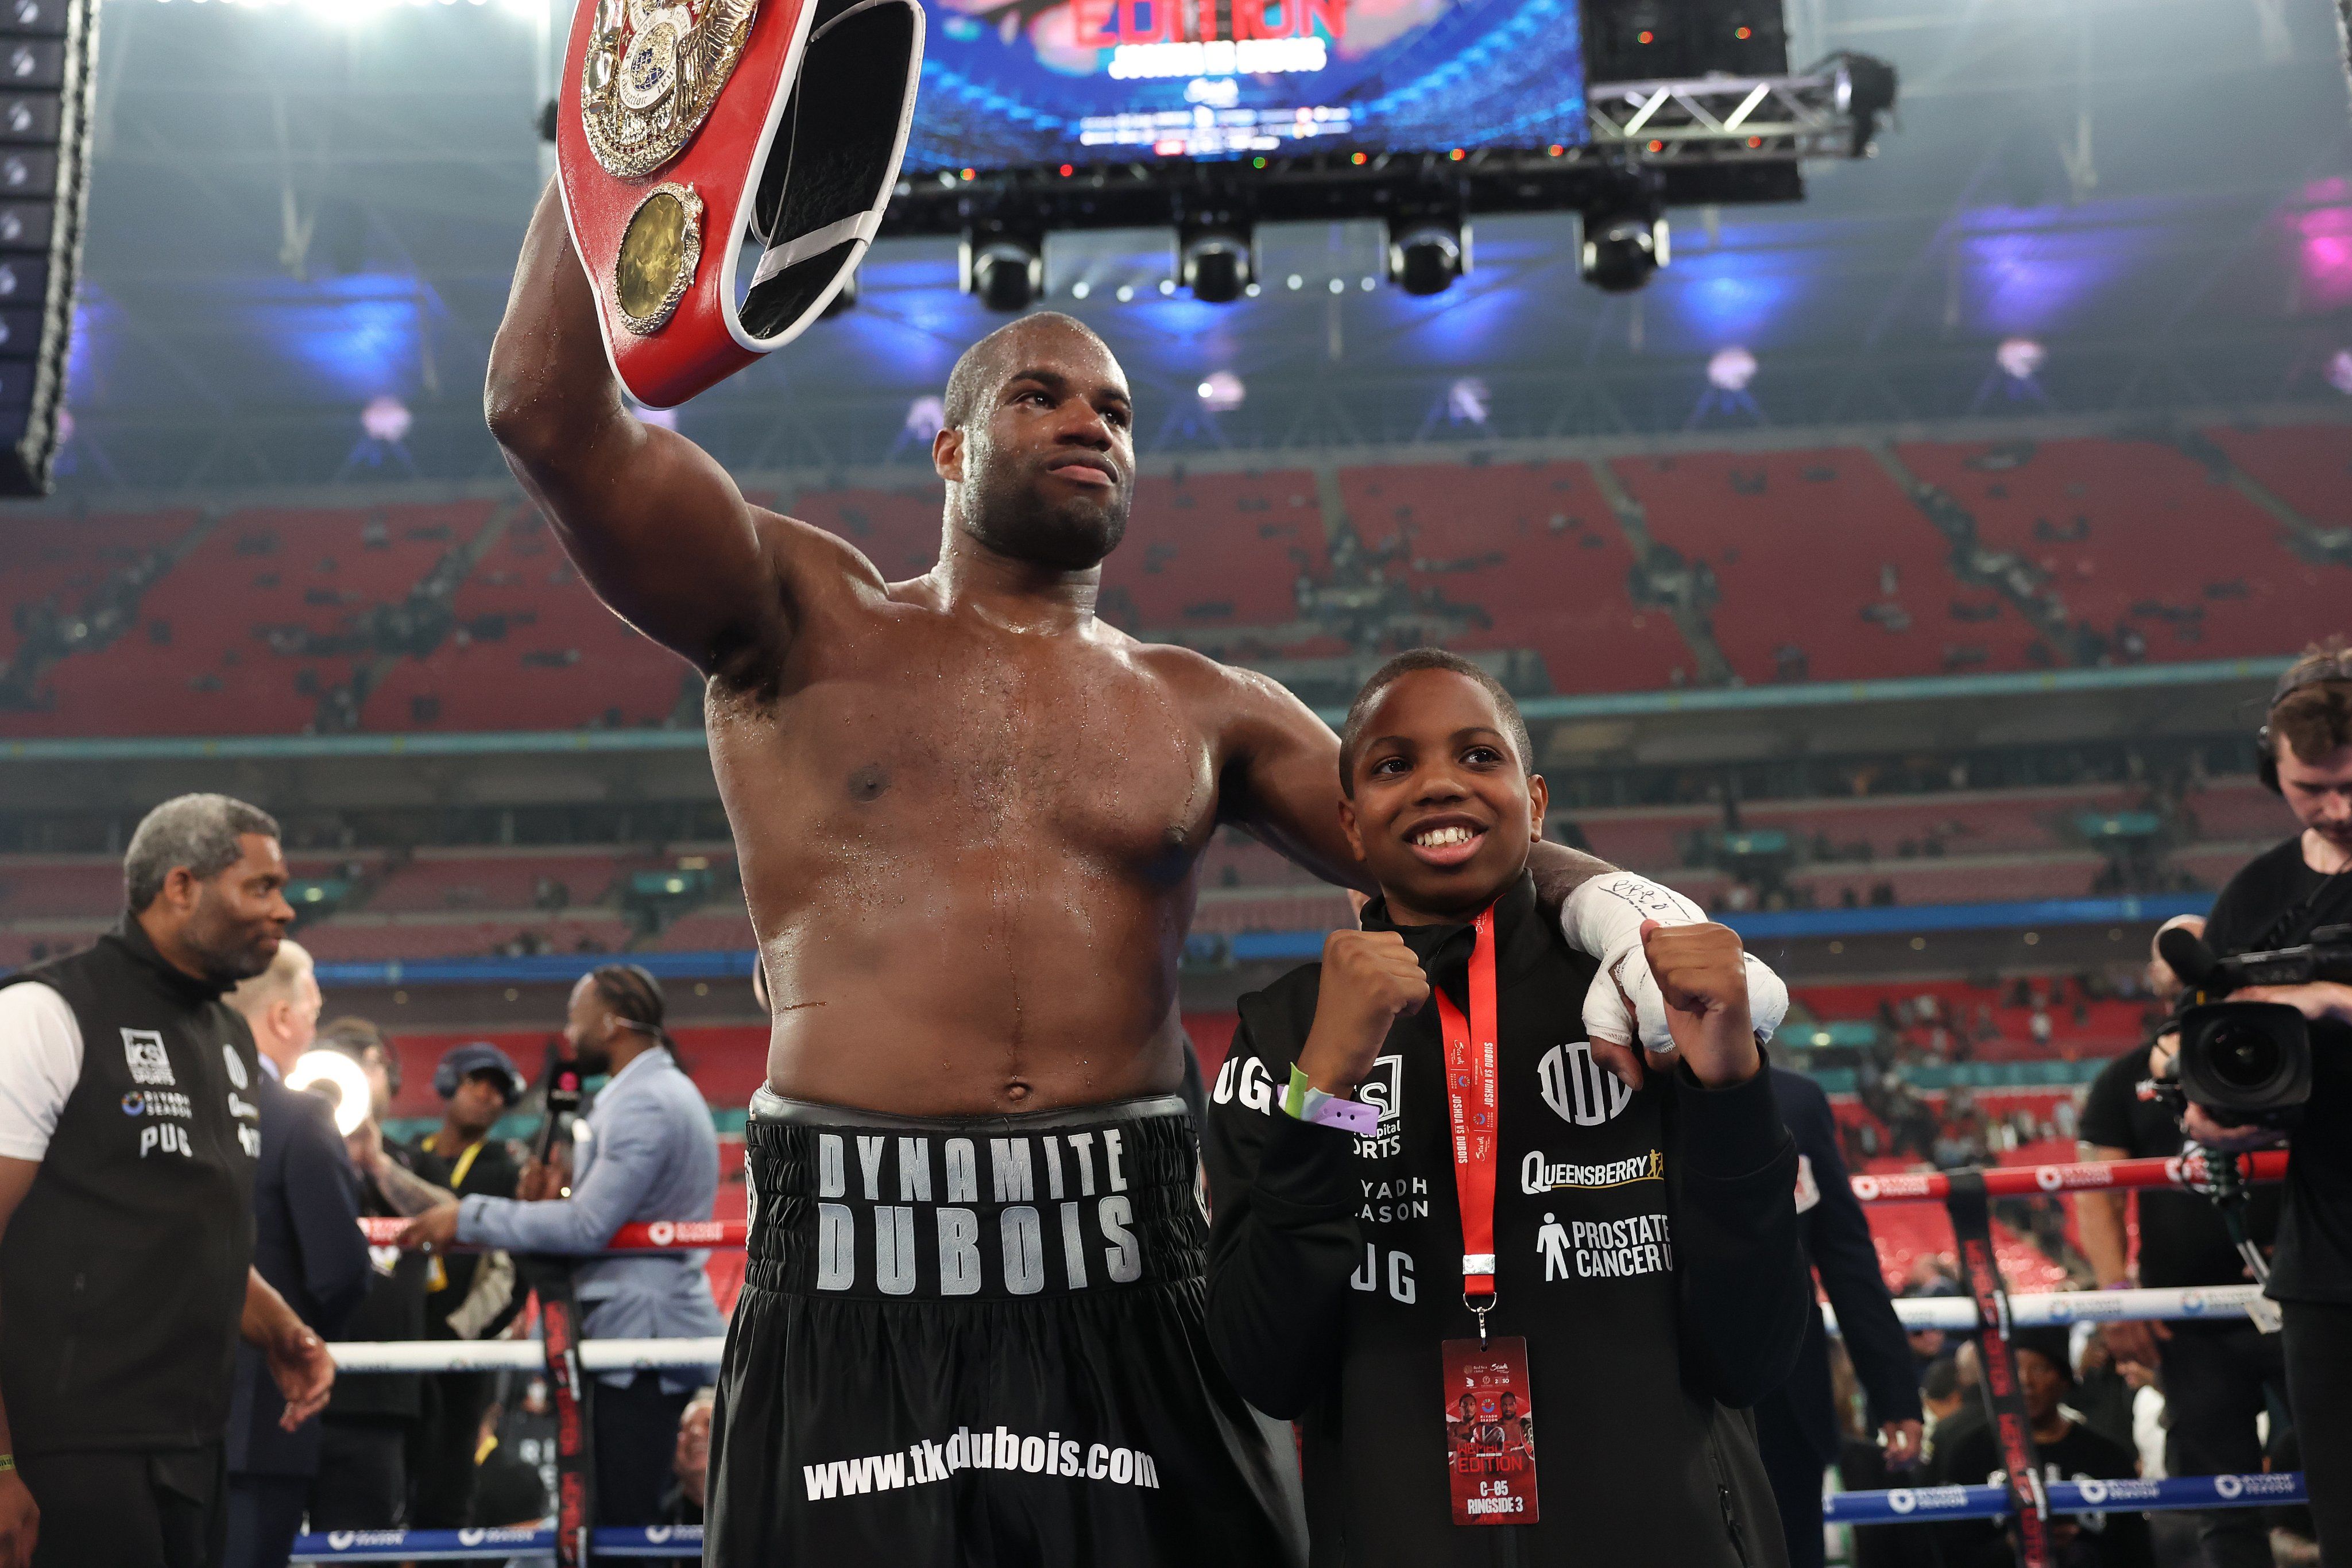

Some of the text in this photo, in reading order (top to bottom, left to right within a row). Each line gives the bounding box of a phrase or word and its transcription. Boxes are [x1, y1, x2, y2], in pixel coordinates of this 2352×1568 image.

[1484, 1042, 1494, 1108] JOSHUA VS DUBOIS
[1452, 1094, 1468, 1164] JOSHUA VS DUBOIS
[818, 1128, 1128, 1203] DYNAMITE
[1360, 1177, 1428, 1200] YADH
[1355, 1201, 1428, 1223] ASON
[816, 1195, 1142, 1296] DUBOIS
[1572, 1214, 1670, 1249] PROSTATE
[1576, 1244, 1662, 1278] CANCER
[803, 1426, 1159, 1501] www.tkdubois.com
[1456, 1441, 1521, 1455] WEMBLEY
[1458, 1456, 1522, 1473] EDITION
[1467, 1496, 1523, 1515] RINGSIDE 3
